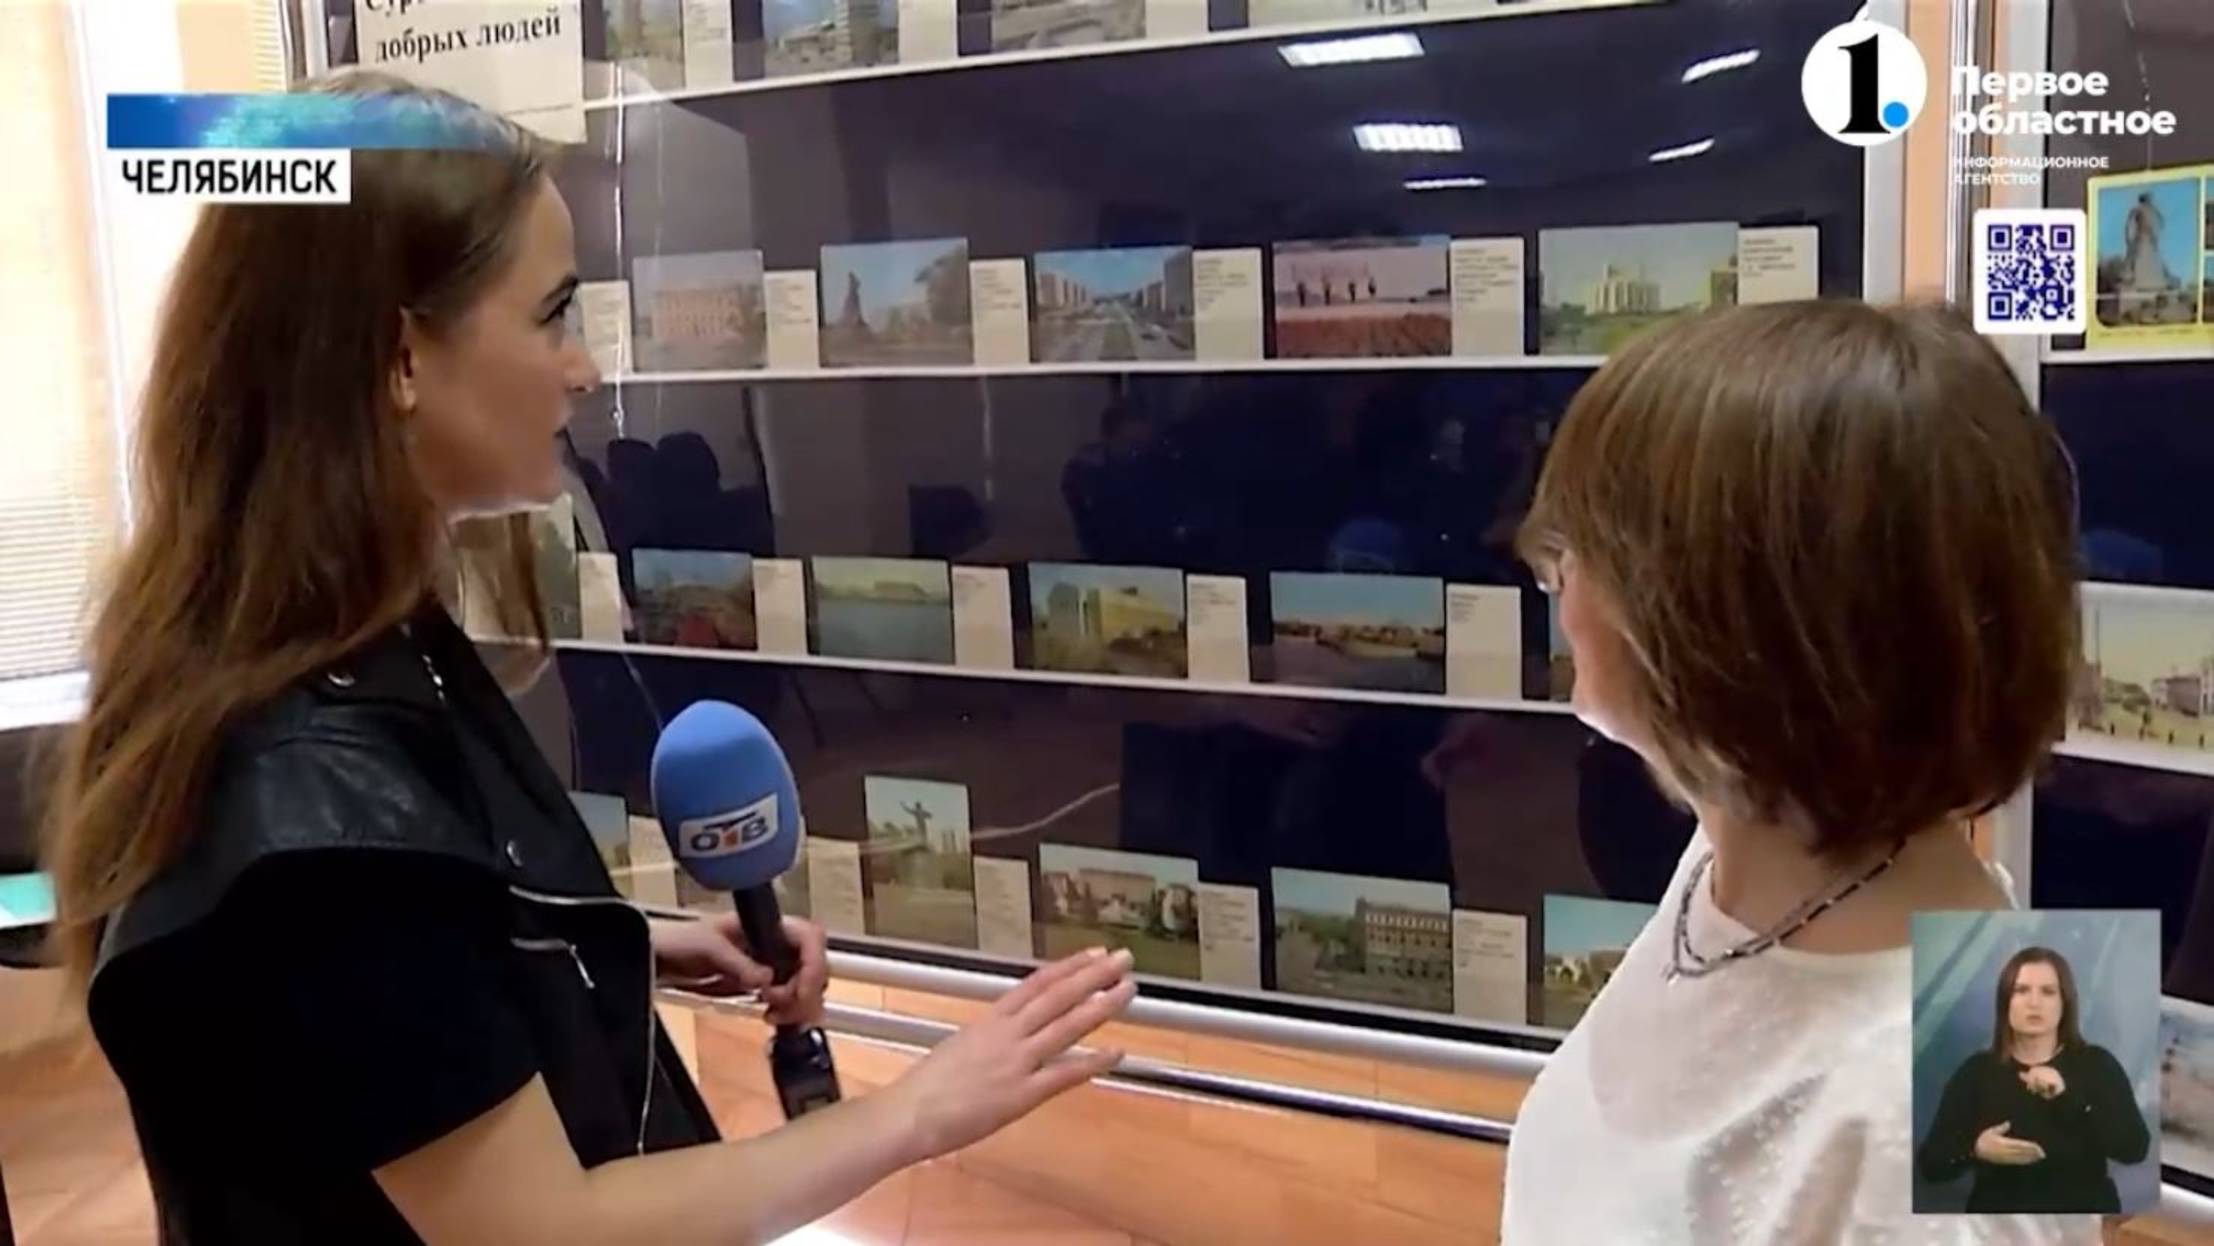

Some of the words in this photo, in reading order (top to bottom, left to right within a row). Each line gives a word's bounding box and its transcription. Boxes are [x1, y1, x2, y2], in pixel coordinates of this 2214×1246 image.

[376, 28, 468, 63] добрых
[476, 7, 561, 46] людей
[690, 811, 769, 851] ОТВ
